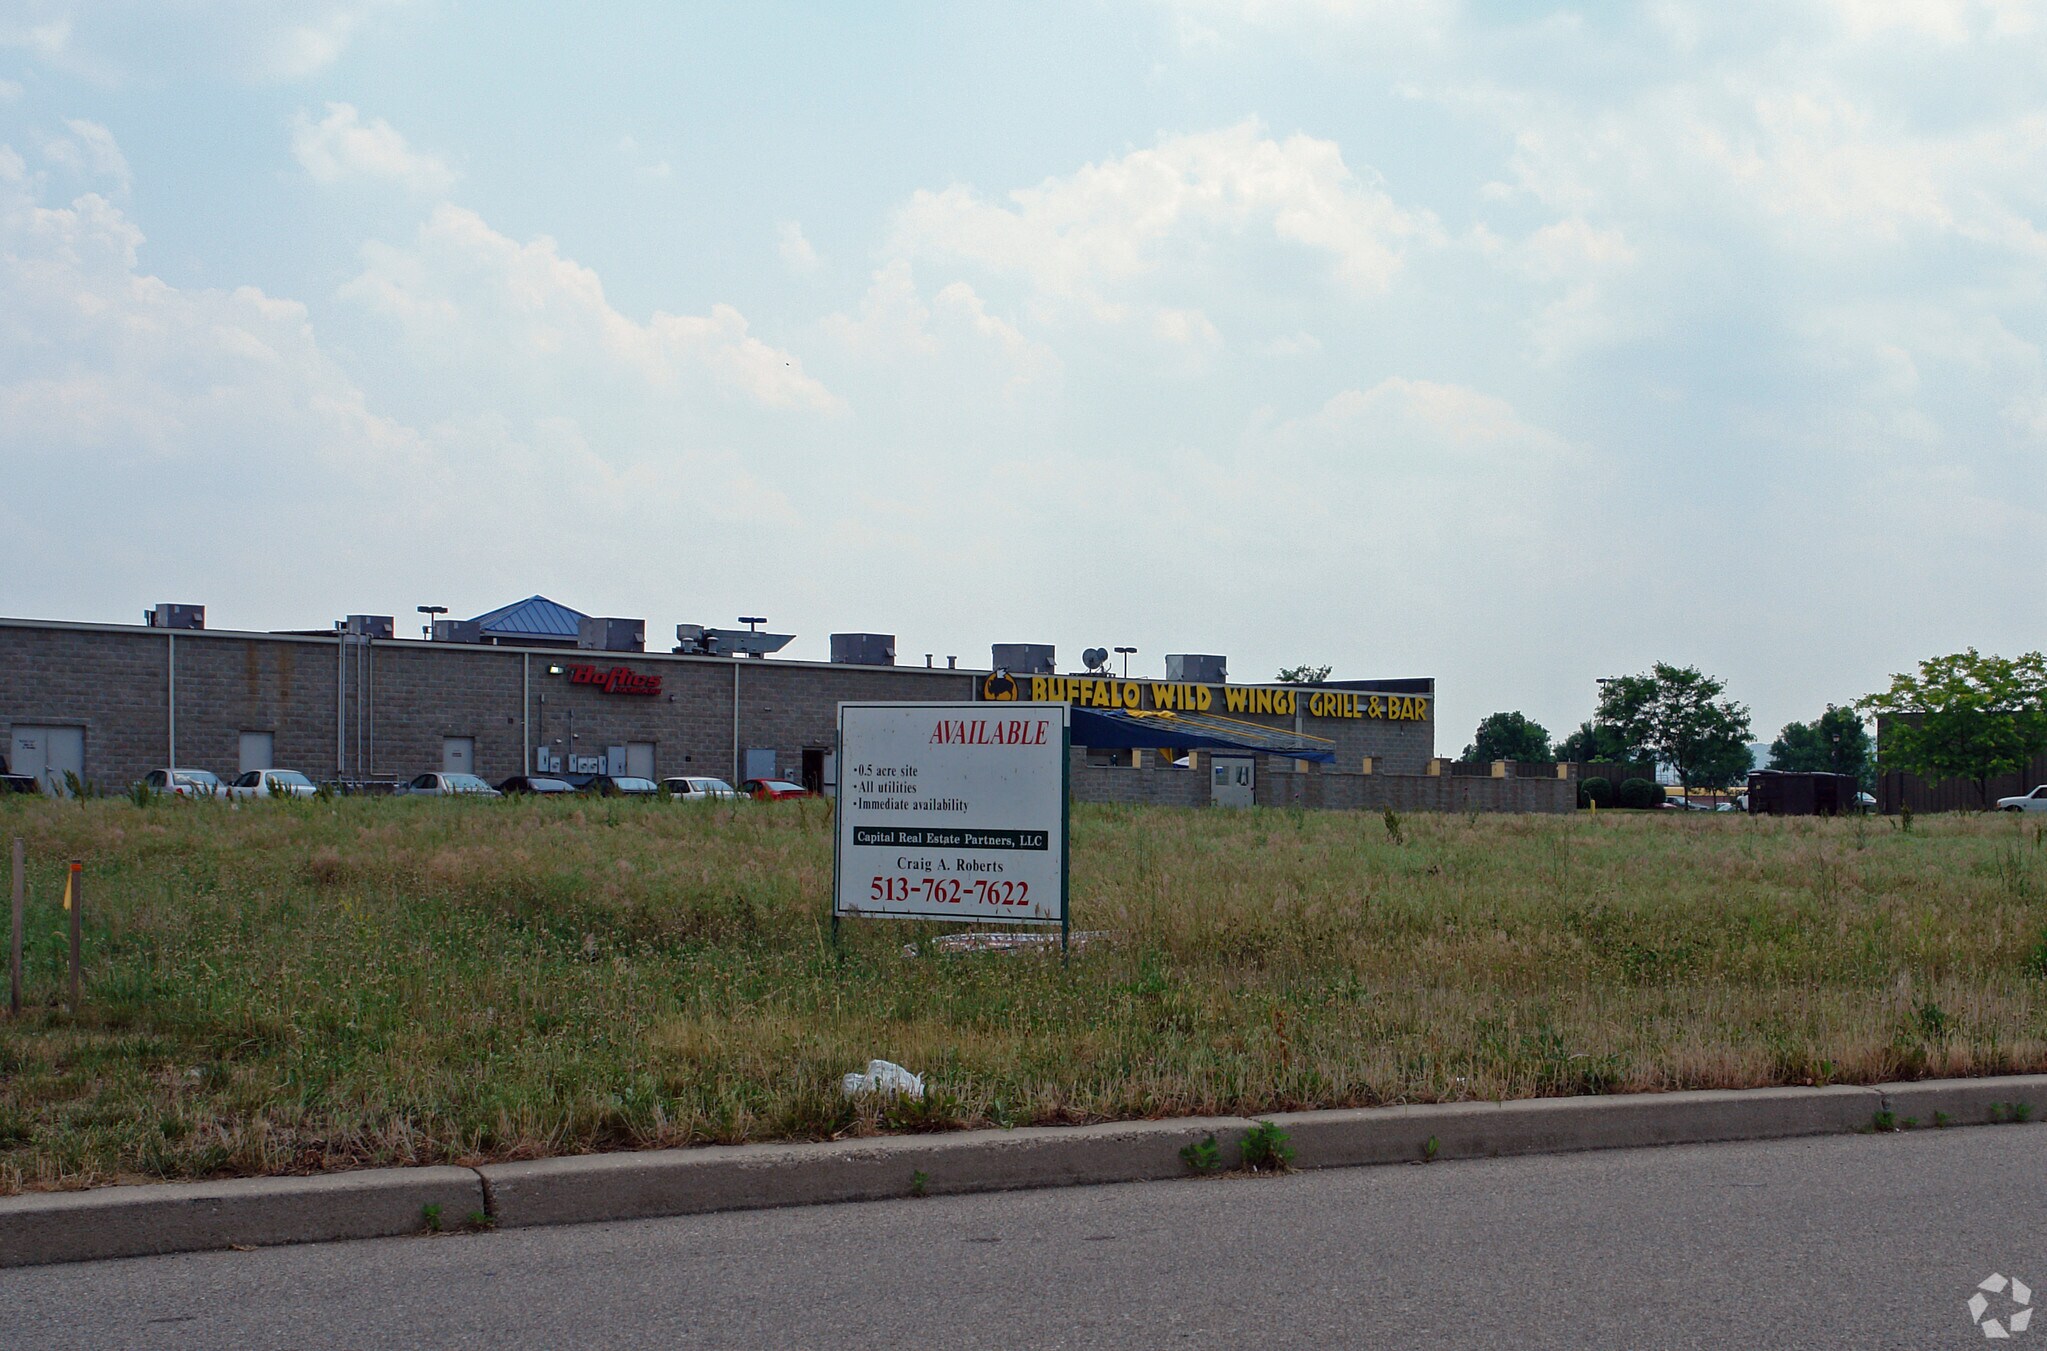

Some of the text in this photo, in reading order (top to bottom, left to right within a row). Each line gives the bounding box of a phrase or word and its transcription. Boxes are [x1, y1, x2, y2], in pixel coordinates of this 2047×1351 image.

[1032, 677, 1427, 720] BUFFALO WILD WINGS GRILL & BAR
[929, 720, 1050, 745] AVAILABLE
[876, 767, 897, 777] acre
[900, 764, 918, 777] site
[878, 780, 917, 794] utilities
[912, 798, 968, 814] availability
[857, 831, 1042, 848] Capital Real Estate Partners, LLC
[897, 856, 1004, 873] Craig A. Roberts
[870, 876, 1029, 906] 513-762-7622
